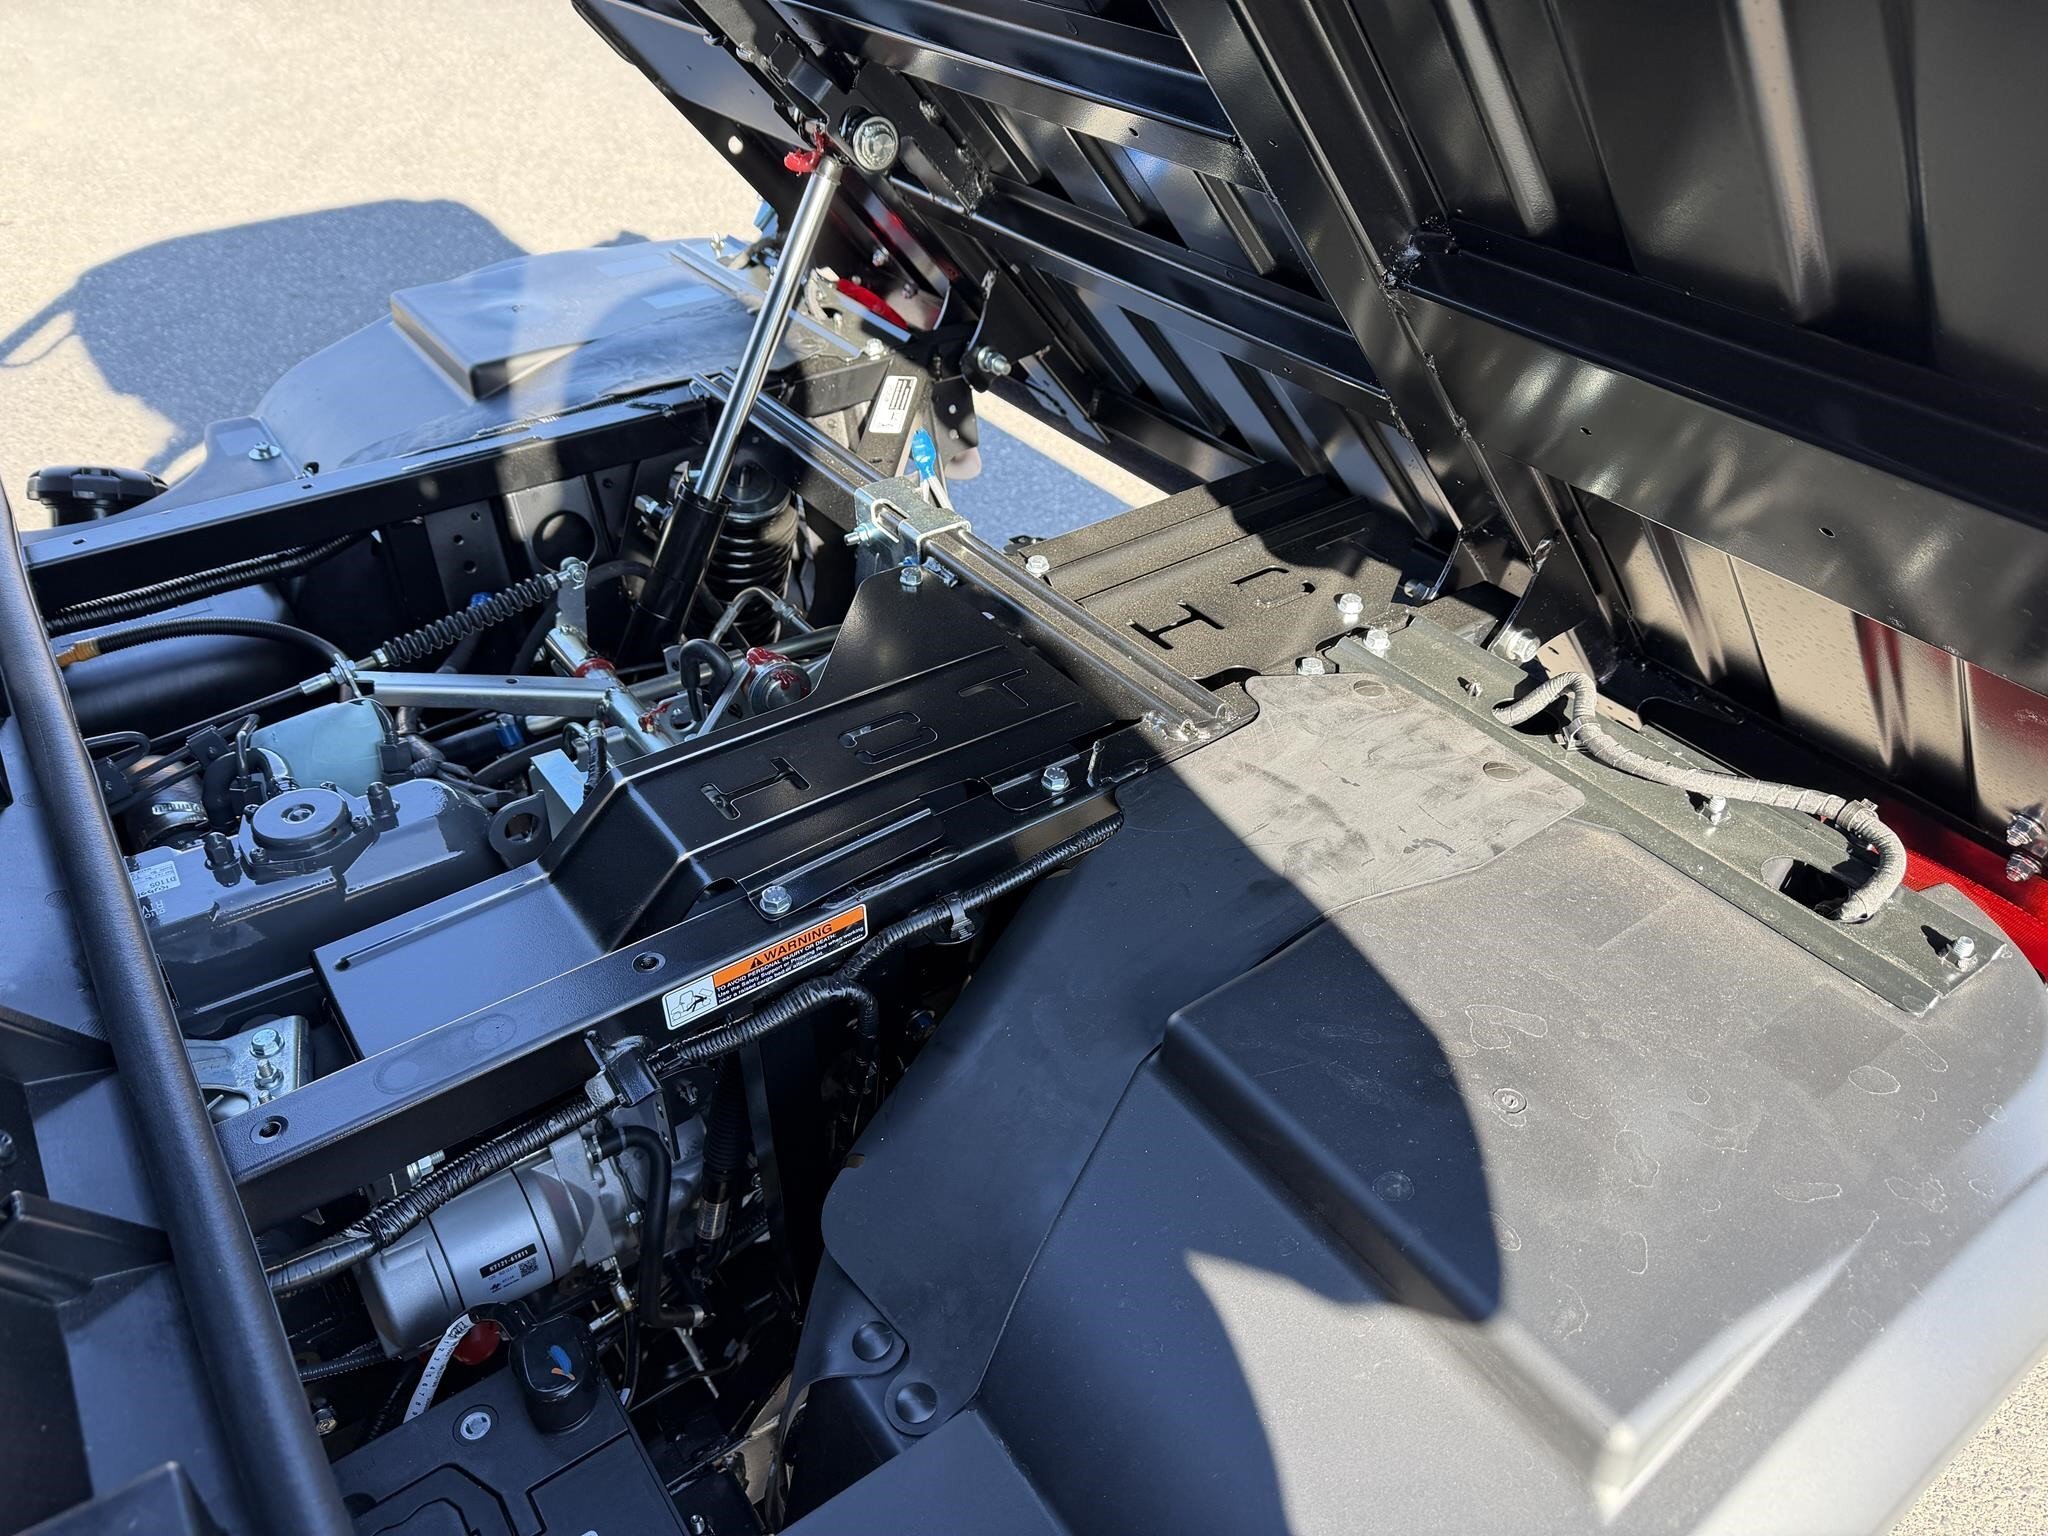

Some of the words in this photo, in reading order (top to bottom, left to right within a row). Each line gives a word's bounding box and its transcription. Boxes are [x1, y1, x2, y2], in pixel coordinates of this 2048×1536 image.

[699, 668, 1030, 821] HOT
[149, 877, 176, 889] D1105
[717, 990, 730, 998] Use
[730, 984, 741, 992] the
[741, 975, 760, 988] Safety
[760, 965, 783, 979] Support
[791, 949, 815, 963] Propping
[816, 943, 828, 952] Rod
[828, 936, 843, 946] when
[843, 926, 864, 939] working
[763, 923, 833, 962] WARNING
[716, 985, 726, 993] TO
[727, 976, 747, 988] AVOID
[747, 960, 781, 978] PERSONAL
[781, 948, 804, 962] INJURY
[804, 943, 815, 951] OR
[718, 995, 732, 1003] near
[739, 983, 757, 994] raised
[757, 975, 774, 987] cargo
[774, 969, 786, 978] bed
